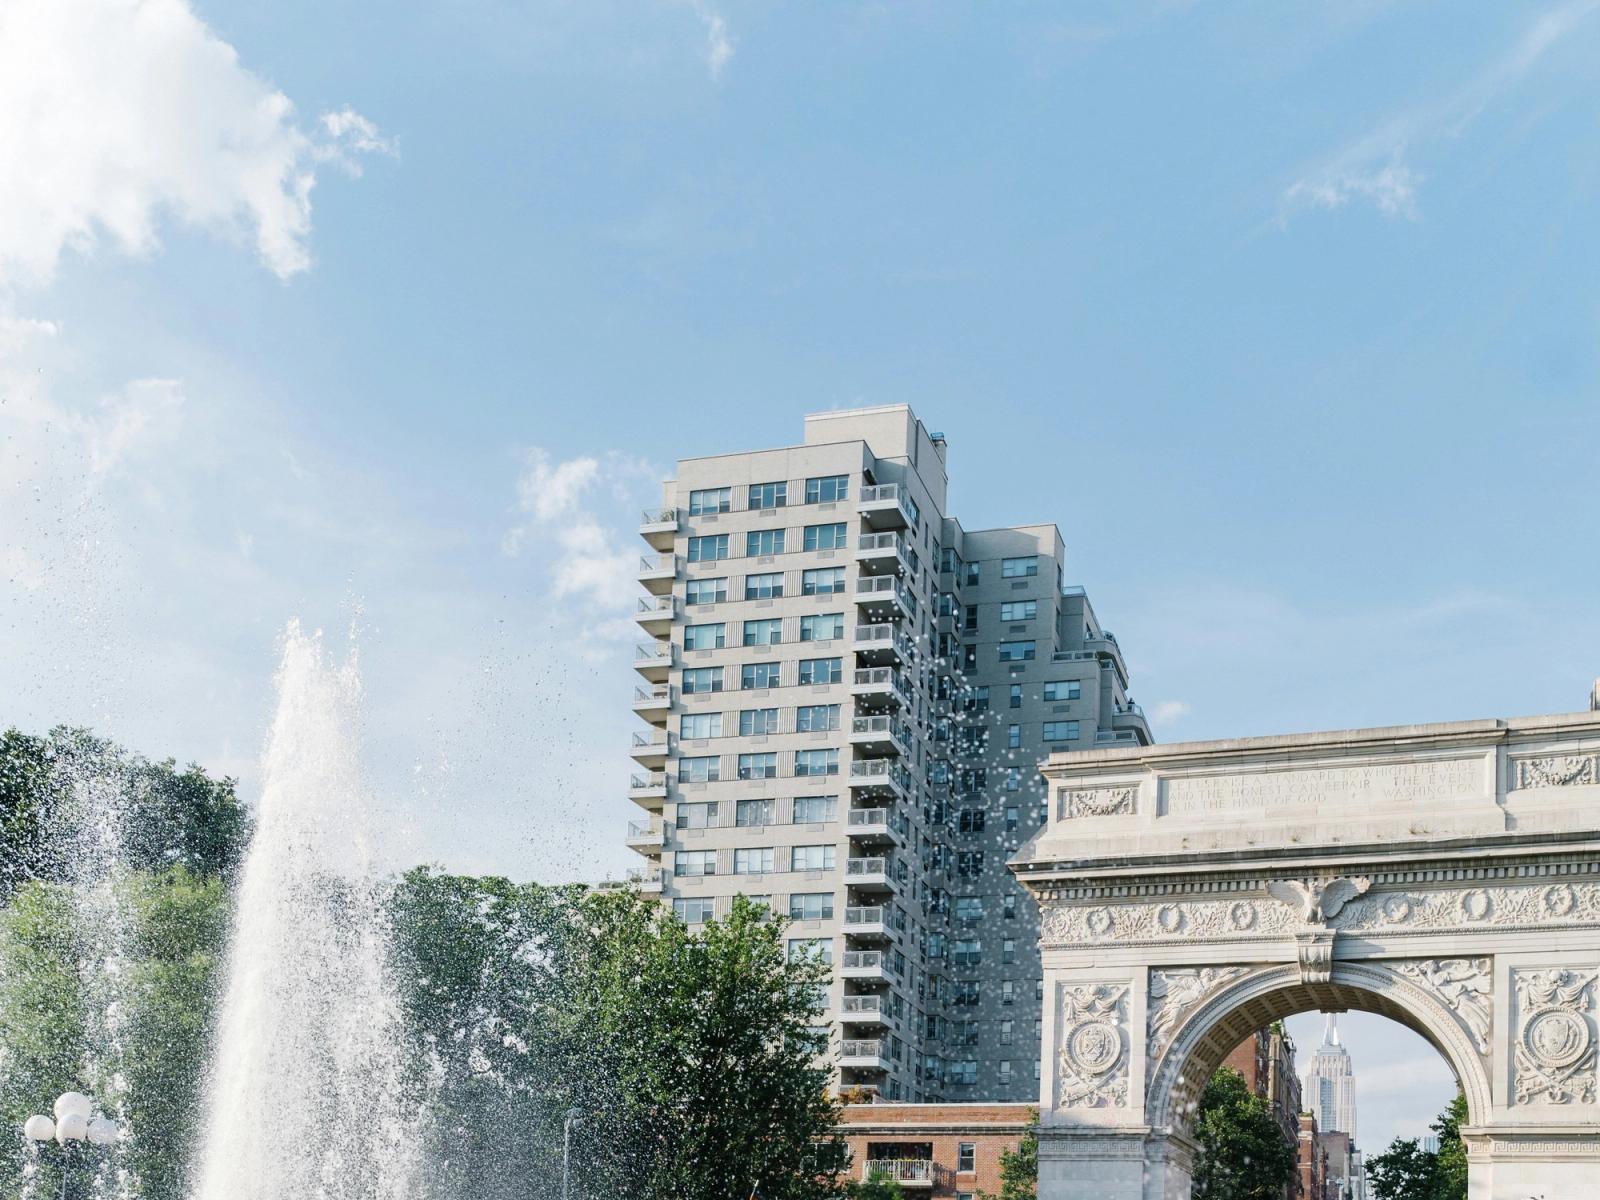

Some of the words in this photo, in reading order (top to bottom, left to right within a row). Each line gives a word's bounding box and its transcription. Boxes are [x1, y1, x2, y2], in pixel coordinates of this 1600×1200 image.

[1266, 771, 1335, 784] STANDARD
[1341, 769, 1359, 779] TO
[1363, 766, 1406, 777] WHICH
[1413, 764, 1438, 774] THE
[1444, 761, 1476, 772] WISE
[1170, 791, 1194, 801] AND
[1199, 789, 1225, 801] THE
[1231, 785, 1281, 798] HONEST
[1289, 783, 1319, 794] CAN
[1325, 779, 1370, 792] REPAIR
[1393, 775, 1420, 787] THE
[1429, 771, 1476, 785] EVENT
[1383, 783, 1476, 799] WASHINGTON
[1184, 801, 1195, 811] IN
[1201, 799, 1226, 809] THE
[1232, 797, 1269, 808] HAND
[1274, 795, 1291, 806] OF
[1297, 793, 1326, 804] GOD
